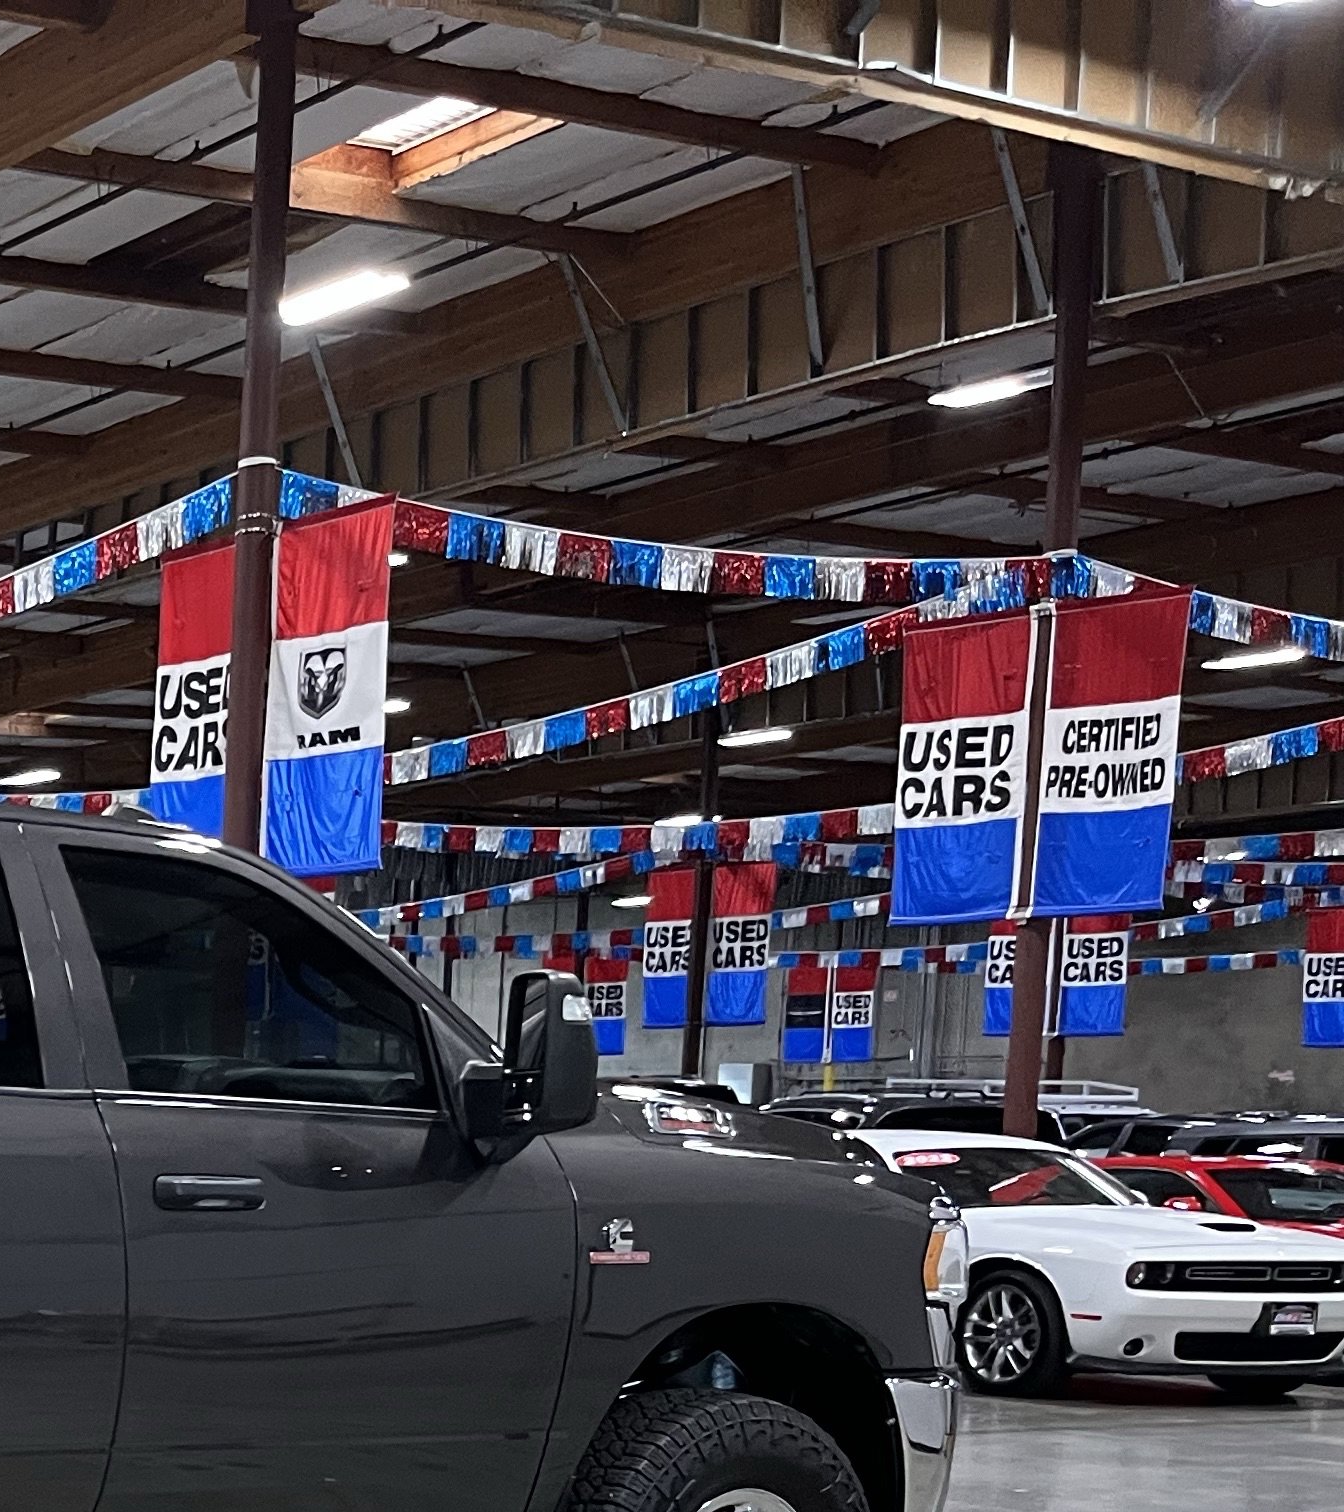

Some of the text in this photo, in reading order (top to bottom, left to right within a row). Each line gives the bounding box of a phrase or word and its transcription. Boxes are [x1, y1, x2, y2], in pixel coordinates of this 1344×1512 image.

[296, 726, 361, 750] RAM
[1062, 713, 1162, 754] CERTIFIED
[154, 720, 228, 772] CAR
[902, 724, 1014, 772] USED
[1045, 757, 1166, 799] PRE-OWNED
[900, 770, 1012, 819] CARS
[713, 919, 768, 944] USED
[712, 943, 767, 968] CARS
[990, 940, 1016, 961] US
[1067, 936, 1124, 960] USED
[988, 963, 1014, 984] CA
[1063, 960, 1124, 984] CARS
[1306, 957, 1344, 977] USE
[1305, 979, 1344, 999] CAR
[592, 1001, 624, 1017] ARS
[835, 994, 872, 1010] USED
[834, 1010, 870, 1026] CARS
